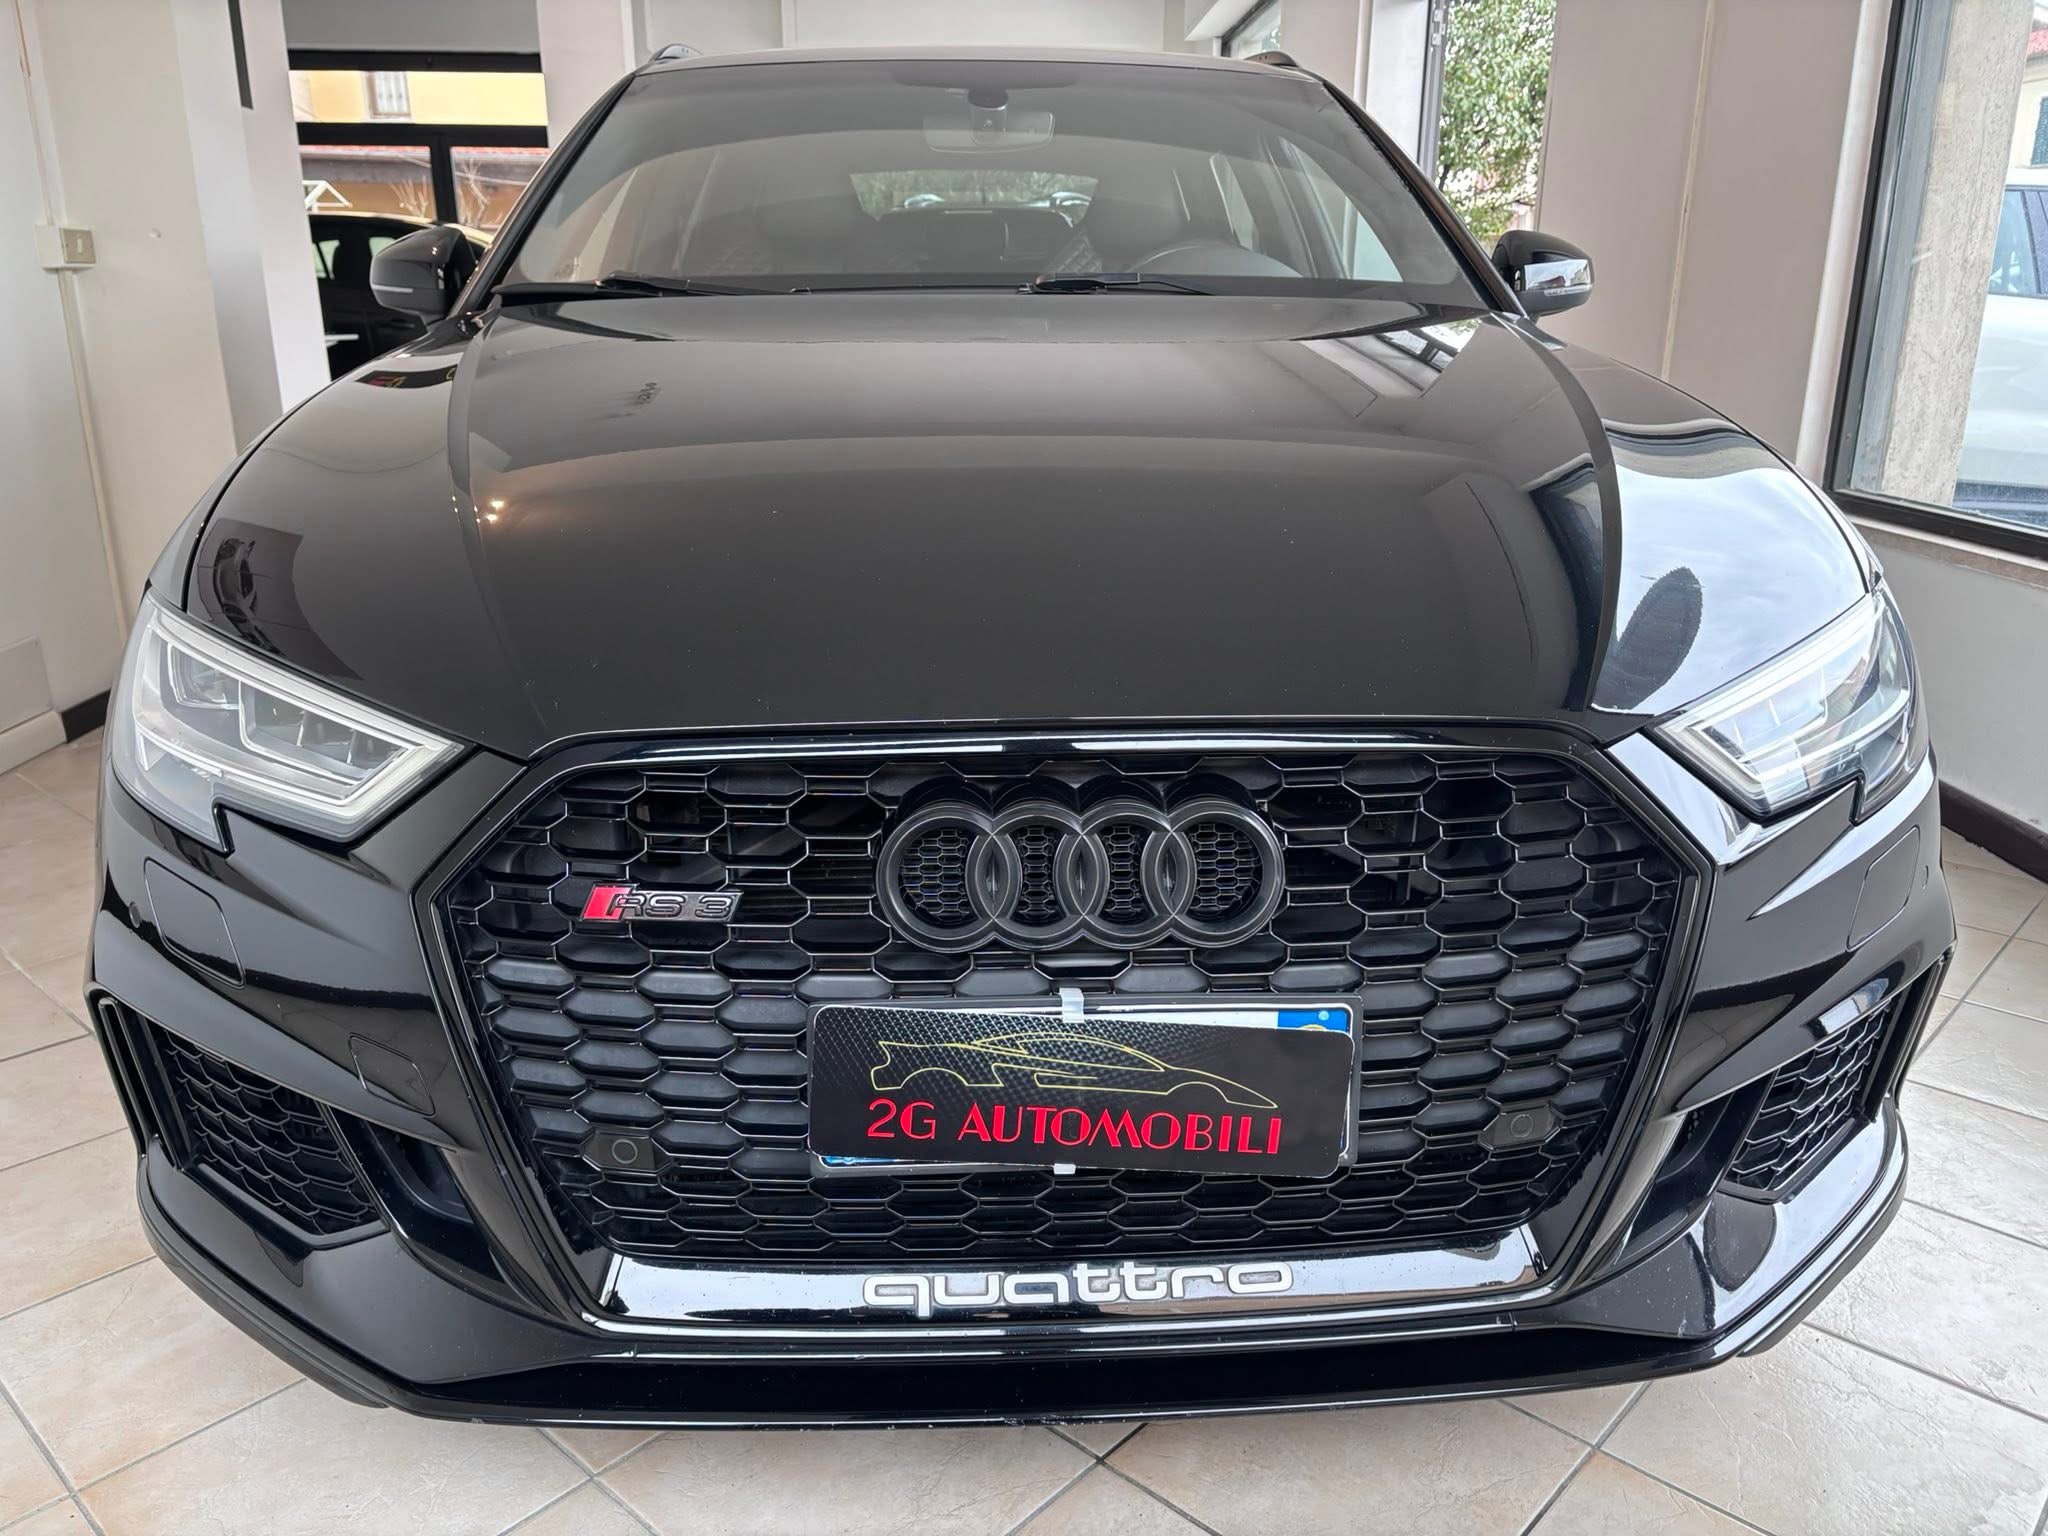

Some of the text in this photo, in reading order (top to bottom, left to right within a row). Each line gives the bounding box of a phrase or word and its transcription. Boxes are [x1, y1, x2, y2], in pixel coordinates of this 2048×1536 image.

[606, 893, 734, 919] RS 3
[866, 1099, 1282, 1154] 2G AUTOMOBILI
[863, 1261, 1294, 1319] quattro
